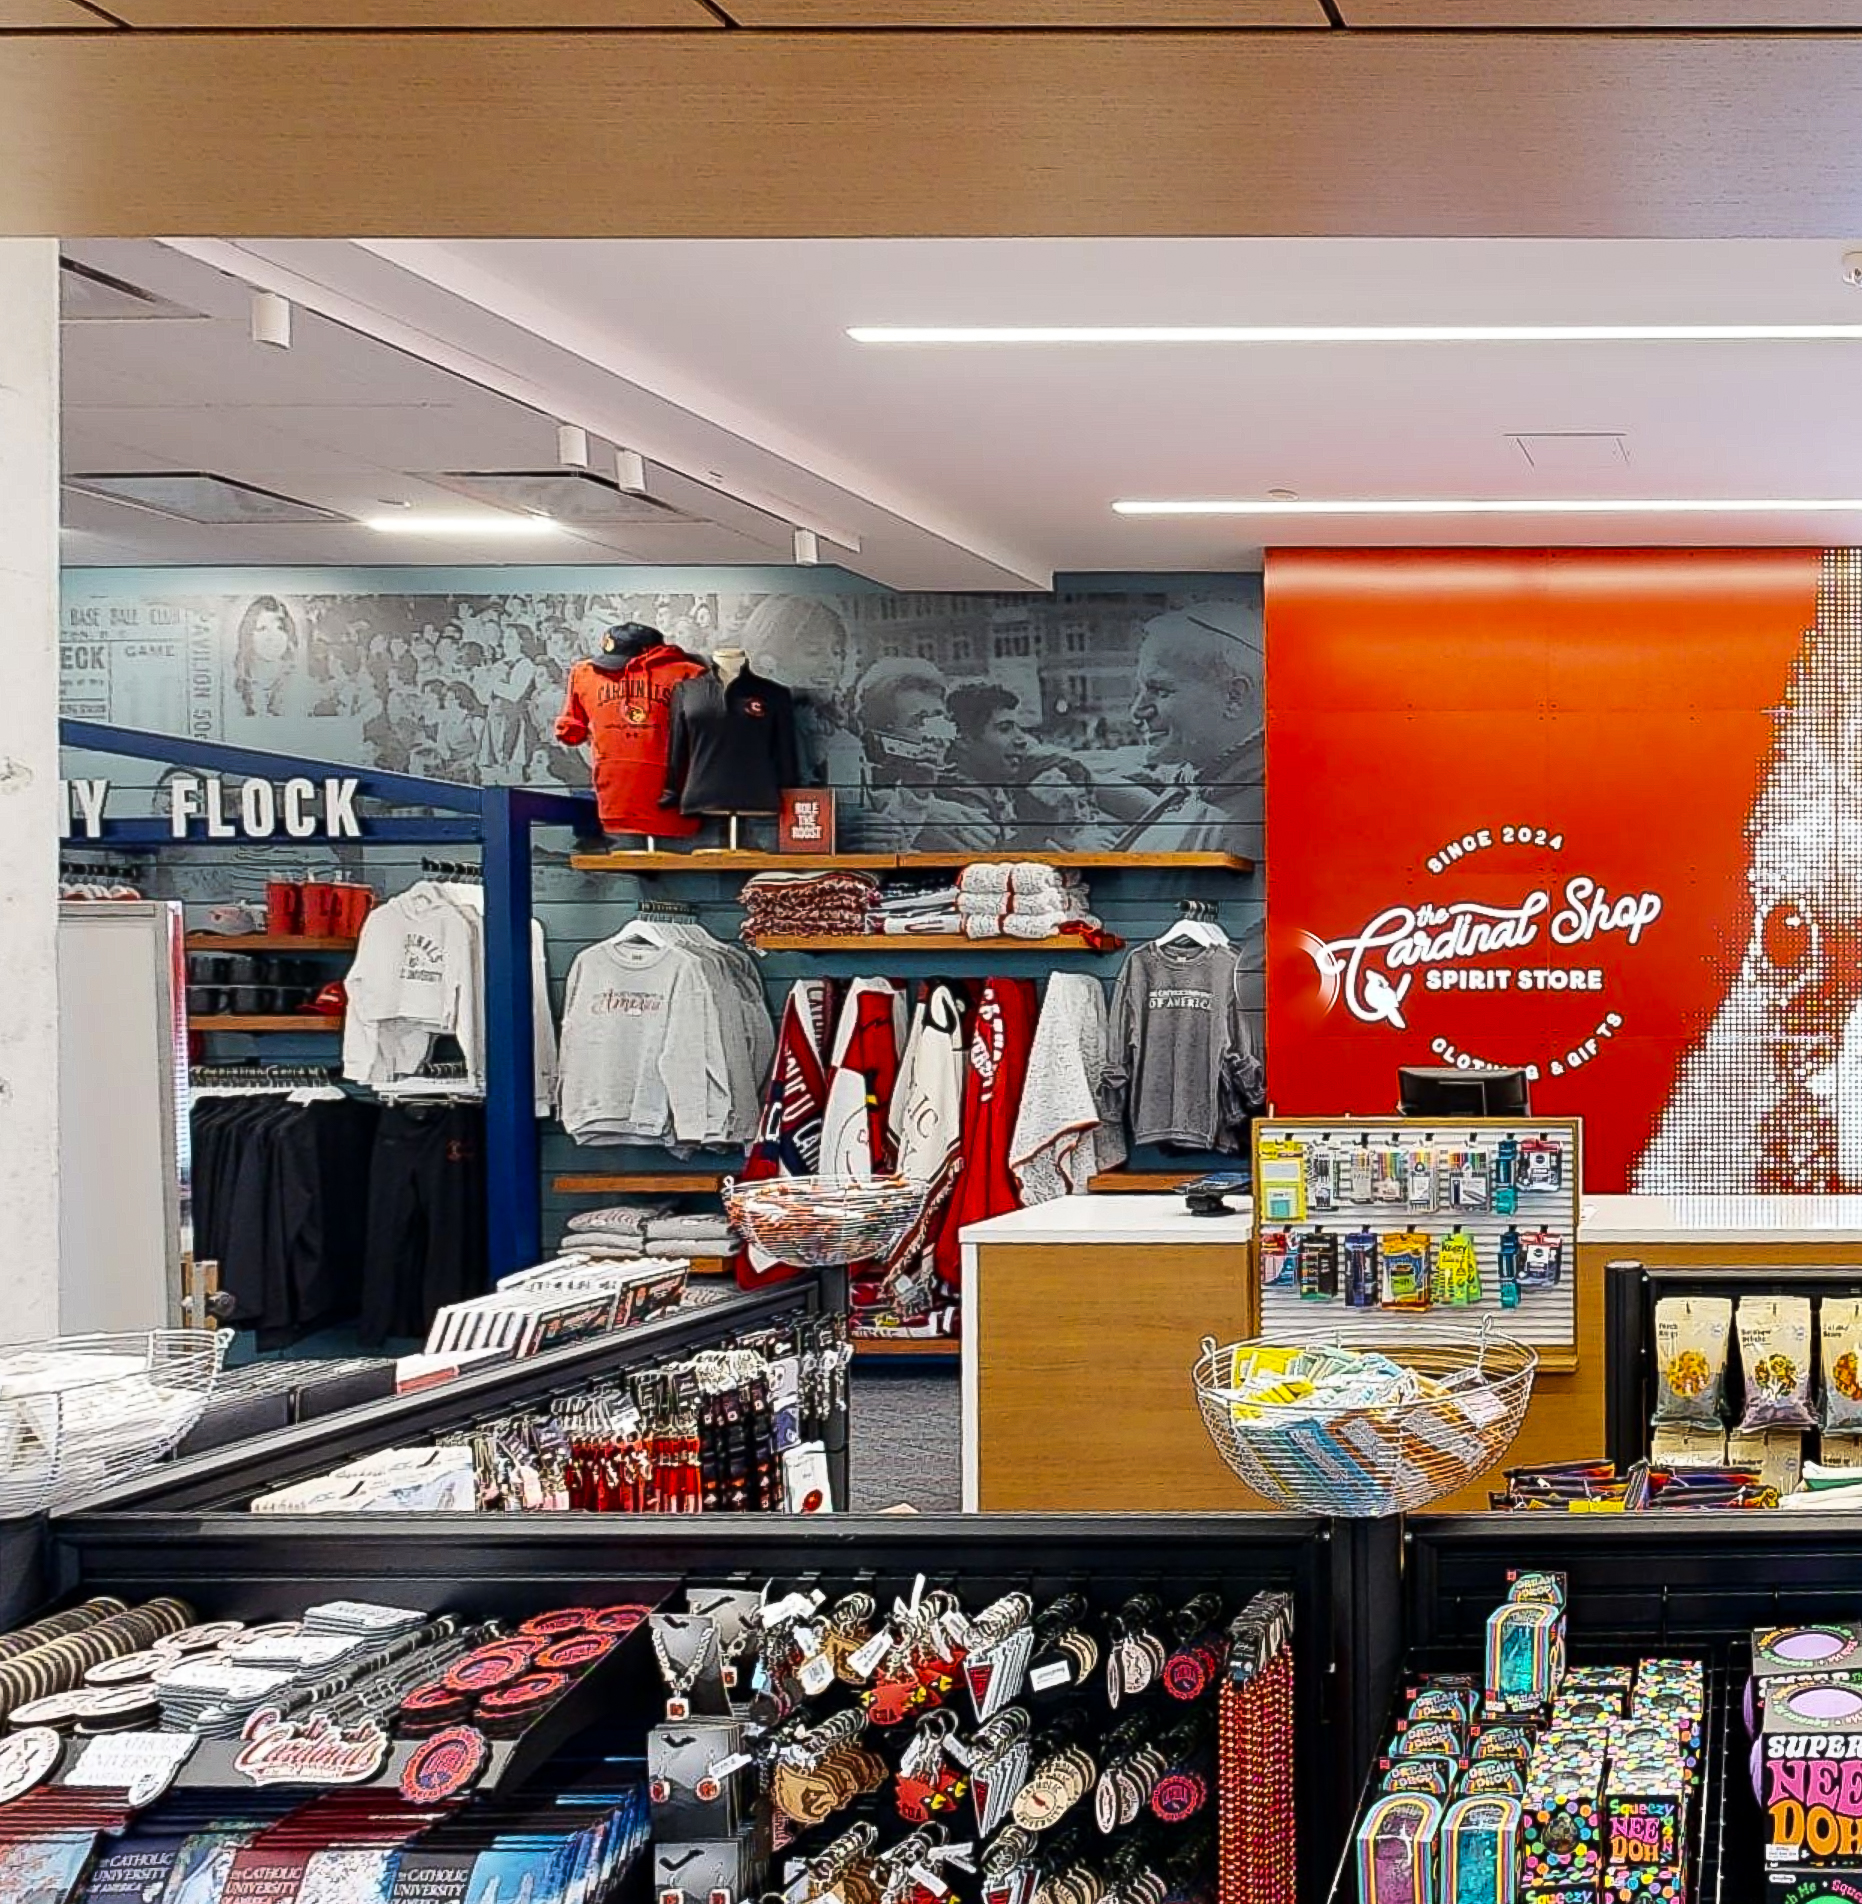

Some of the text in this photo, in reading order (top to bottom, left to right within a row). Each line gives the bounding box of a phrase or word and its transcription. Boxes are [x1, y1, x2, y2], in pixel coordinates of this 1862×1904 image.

[171, 777, 362, 838] FLOCK
[1426, 826, 1564, 875] SINCE 2024
[1415, 903, 1451, 928] the
[1316, 876, 1662, 1022] Cardinal Shop
[1425, 969, 1603, 990] SPIRIT STORE
[1431, 1011, 1624, 1081] CLOTG & GIFTS
[1609, 1799, 1675, 1818] Squeezy
[1610, 1816, 1660, 1844] NEE
[1610, 1835, 1660, 1863] DOH
[110, 1852, 176, 1868] CATHOLIC
[93, 1867, 171, 1881] UNIVERSITY
[244, 1866, 302, 1881] CATHOLIC
[406, 1868, 468, 1882] CATHOLIC
[225, 1881, 298, 1895] UNIVERSITY
[394, 1883, 466, 1897] UNIVERSITY
[1525, 1889, 1593, 1904] Squeezy
[1797, 1882, 1818, 1897] Me
